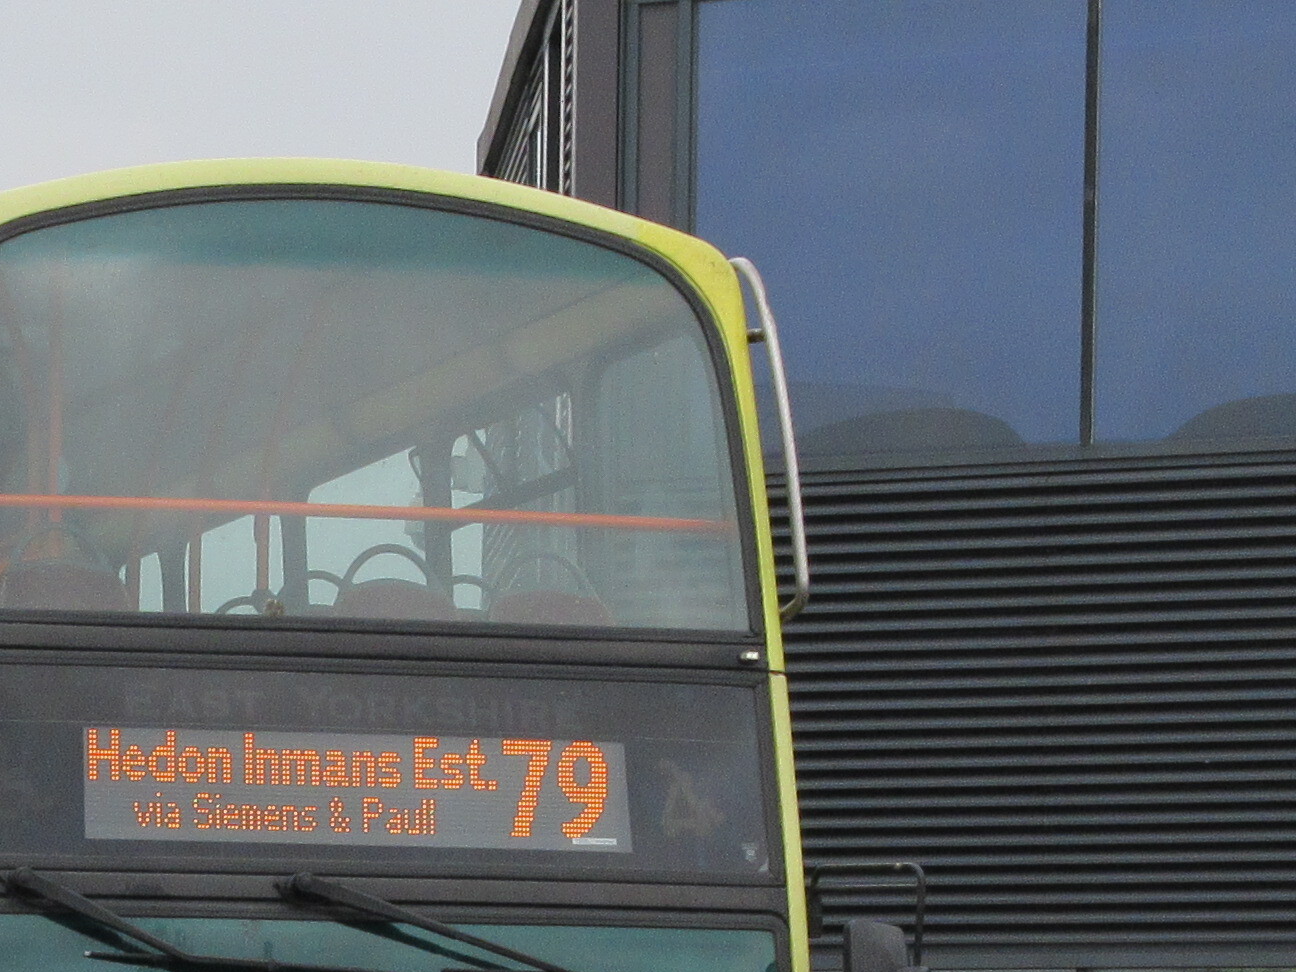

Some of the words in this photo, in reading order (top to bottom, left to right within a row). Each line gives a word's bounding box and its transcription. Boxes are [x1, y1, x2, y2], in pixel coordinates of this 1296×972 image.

[87, 728, 233, 784] Hedon
[243, 732, 402, 789] Inmans
[413, 736, 499, 791] Est.
[501, 738, 609, 839] 79
[132, 791, 181, 829] via
[191, 791, 319, 832] Siemens
[328, 797, 351, 834] &
[360, 796, 436, 836] Paull
